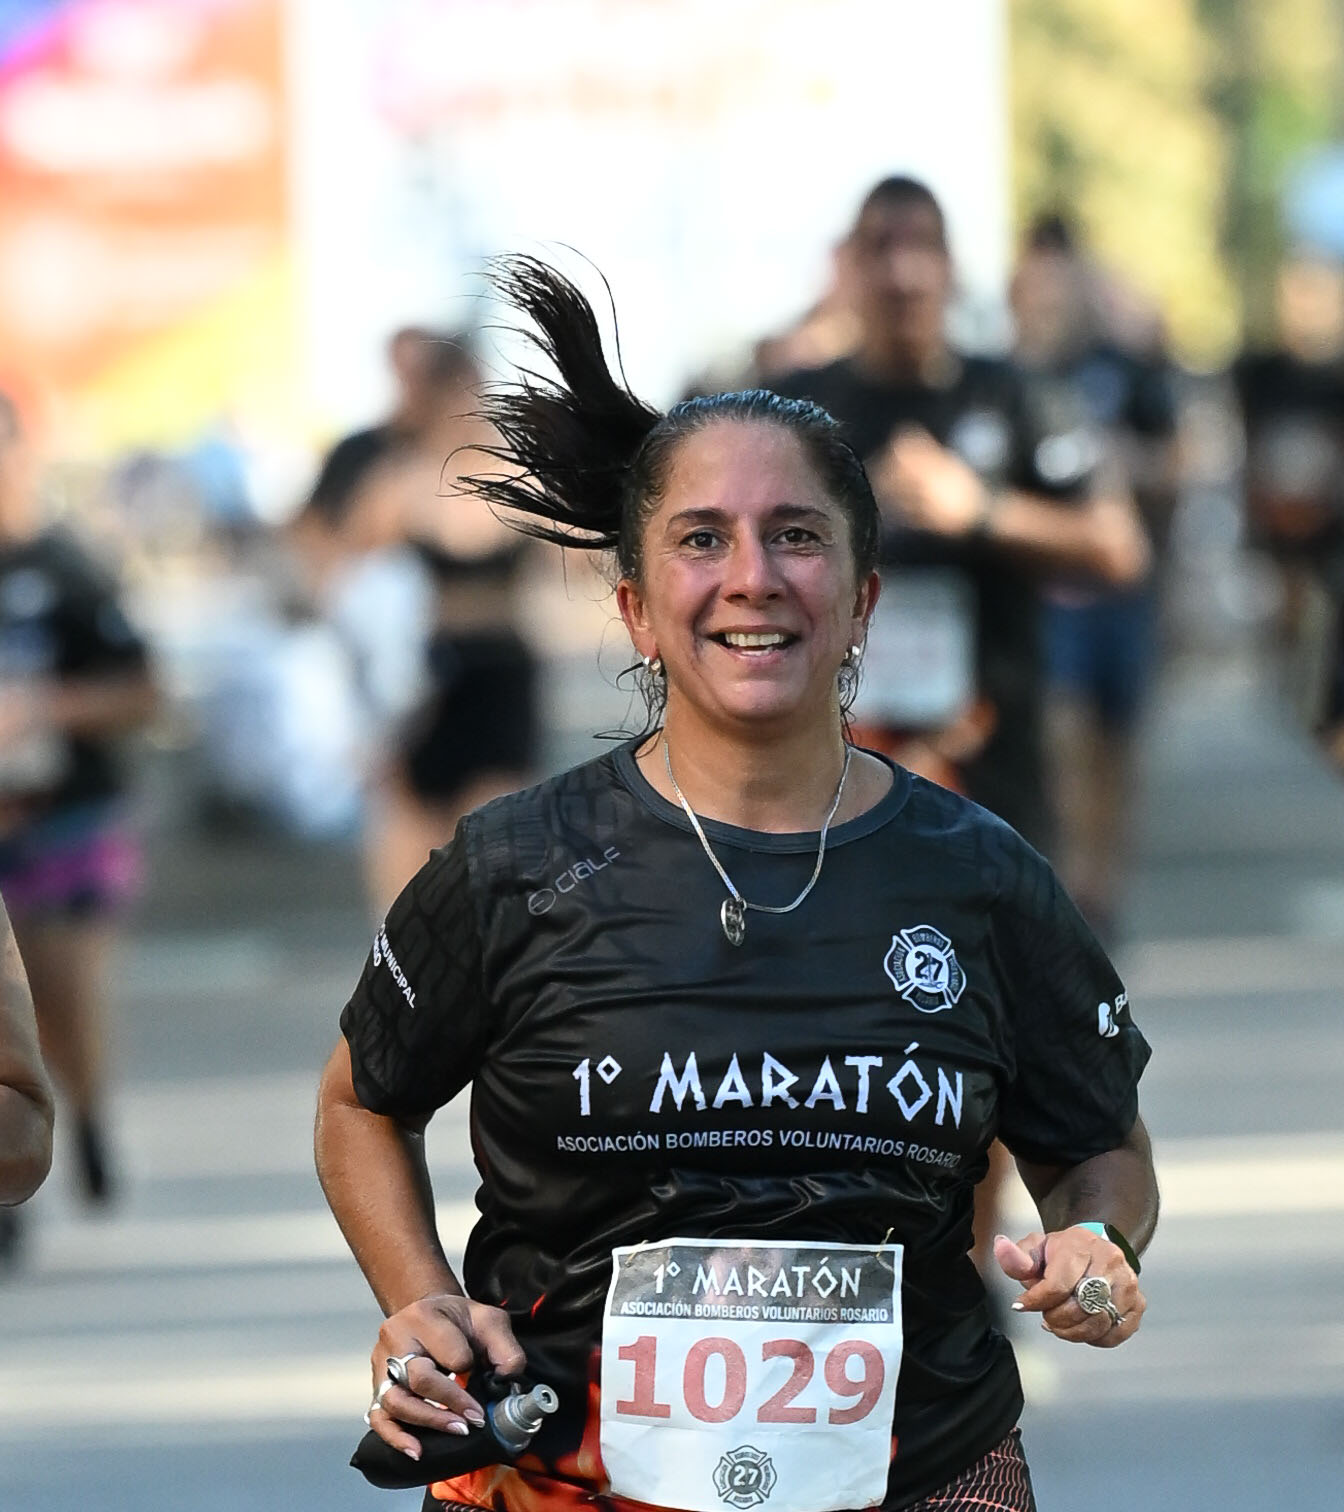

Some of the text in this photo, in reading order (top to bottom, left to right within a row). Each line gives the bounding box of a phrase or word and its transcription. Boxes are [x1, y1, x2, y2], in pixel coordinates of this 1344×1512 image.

[380, 933, 416, 1009] MUNICIPAL
[914, 950, 944, 982] 27
[649, 1041, 963, 1131] MARATÓN
[557, 1130, 961, 1168] ASOCIACIÓN BOMBEROS VOLUNTARIOS ROSARIO
[691, 1256, 862, 1299] MARATÓN
[620, 1298, 890, 1322] ASOCIACIÓN BOMBEROS VOLUNTARIOS ROSARIO
[616, 1335, 886, 1425] 1029
[733, 1464, 759, 1487] 27
